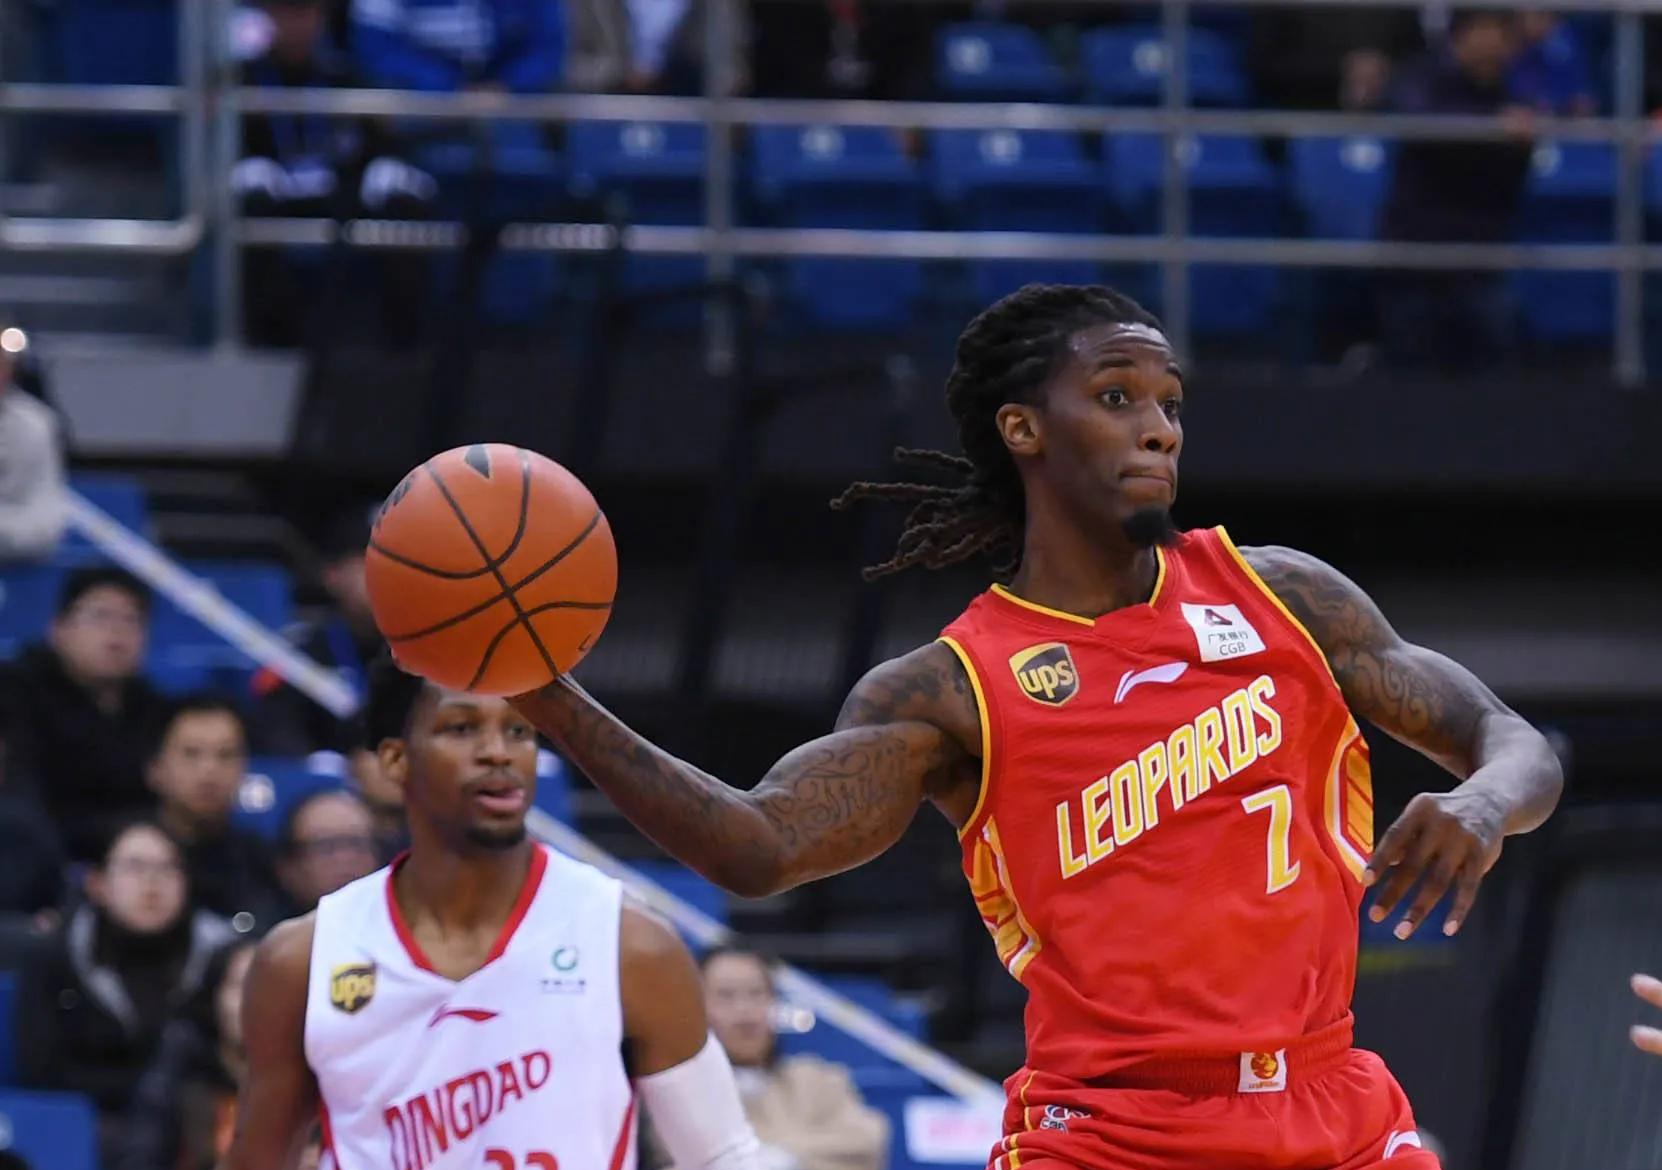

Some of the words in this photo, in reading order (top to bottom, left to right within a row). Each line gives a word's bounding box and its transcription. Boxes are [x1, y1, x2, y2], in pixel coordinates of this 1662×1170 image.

[1219, 636, 1247, 656] CGB
[1019, 660, 1074, 699] ups
[1056, 674, 1282, 880] LEOPARDS
[332, 974, 375, 1010] ups
